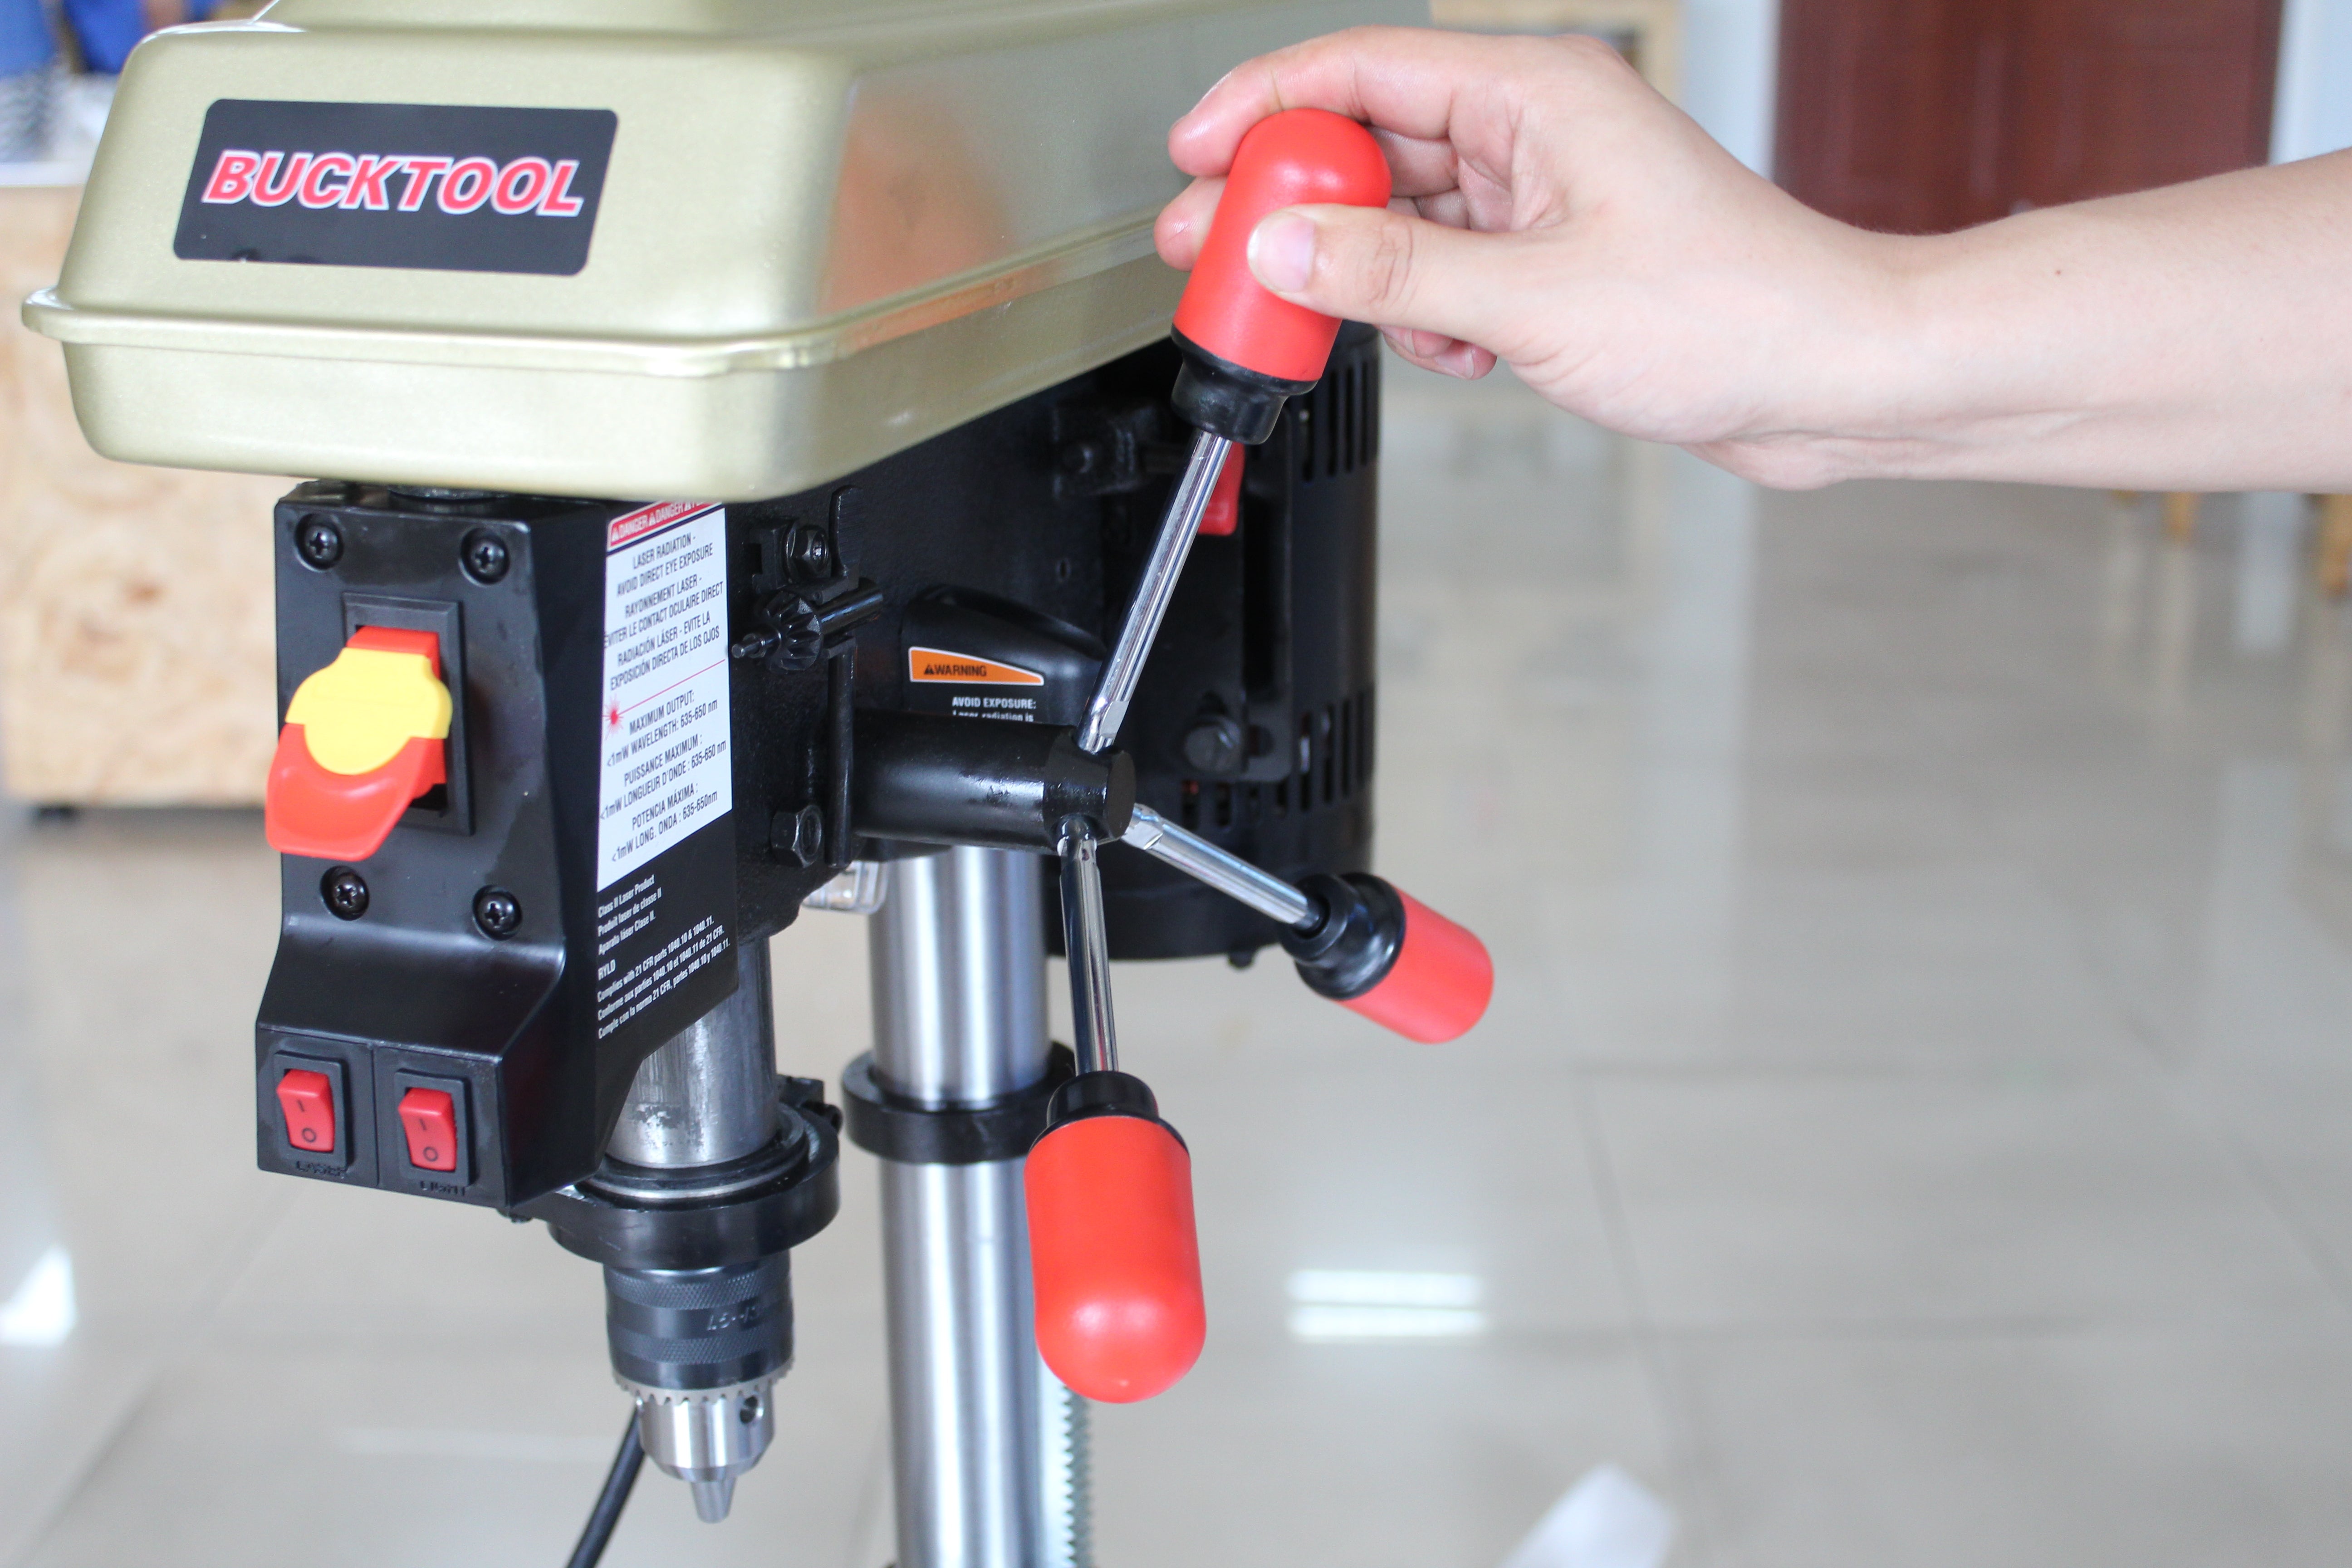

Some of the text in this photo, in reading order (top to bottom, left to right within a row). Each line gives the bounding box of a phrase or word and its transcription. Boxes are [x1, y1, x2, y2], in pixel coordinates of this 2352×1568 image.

[201, 150, 584, 216] BUCKTOOL
[617, 542, 713, 596] AVOID DIRECT EYE EXPOSURE
[633, 549, 654, 569] LASER
[656, 533, 691, 559] RADIATION
[625, 584, 675, 618] RAYONNEMENT
[677, 574, 697, 594] LASER
[629, 622, 637, 636] LE
[638, 608, 667, 632] CONTACT
[669, 592, 699, 618] OCULAIRE
[701, 581, 723, 602] DIRECT
[611, 626, 720, 691] EXPOSICIÓN DIRECTA DE LOS OJOS
[618, 637, 655, 667] RADIACIÓN
[657, 629, 678, 647] LÁSER
[684, 615, 701, 634] EVITE
[703, 611, 710, 625] LA
[934, 664, 987, 676] WARNING
[629, 689, 694, 735] MAXIMUM OUTPUT:
[631, 718, 679, 755] WAVELENGTH:
[681, 702, 706, 728] 635-650
[708, 699, 717, 713] nm
[952, 696, 1036, 709] AVOID EXPOSURE:
[1025, 712, 1034, 722] is
[624, 754, 662, 787] PUISSANCE
[665, 733, 698, 764] MAXIMUM
[624, 775, 661, 807] LONGUEUR
[662, 760, 686, 786] D'ONDE
[691, 744, 715, 769] 635-650
[717, 740, 726, 754] nm
[632, 800, 666, 830] POTENCIA
[667, 782, 694, 810] MÁXIMA
[636, 827, 657, 849] LONG.
[658, 812, 677, 835] ONDA
[683, 791, 718, 820] 635-650nm
[598, 902, 613, 918] Class
[619, 889, 634, 905] Laser
[635, 874, 654, 895] Product
[632, 903, 640, 915] de
[640, 892, 657, 910] classe
[598, 935, 620, 956] Aparato
[635, 916, 649, 931] Clase
[597, 979, 623, 1002] Complies
[623, 970, 635, 985] with
[635, 964, 642, 977] 21
[642, 956, 653, 971] CFR
[654, 948, 667, 966] parts
[667, 932, 687, 954] 1040.10
[688, 929, 692, 940] &
[598, 959, 616, 980] RYLD
[598, 997, 624, 1021] Conforme
[624, 989, 634, 1003] aux
[635, 977, 652, 998] parties
[652, 960, 673, 982] 1040.10
[673, 956, 679, 968] et
[679, 942, 698, 964] 1040.11
[699, 939, 706, 950] de
[706, 932, 712, 945] 21
[630, 1006, 635, 1017] la
[652, 987, 659, 1001] 21
[673, 969, 688, 989] partes
[688, 953, 707, 975] 1040.10
[707, 952, 710, 964] y
